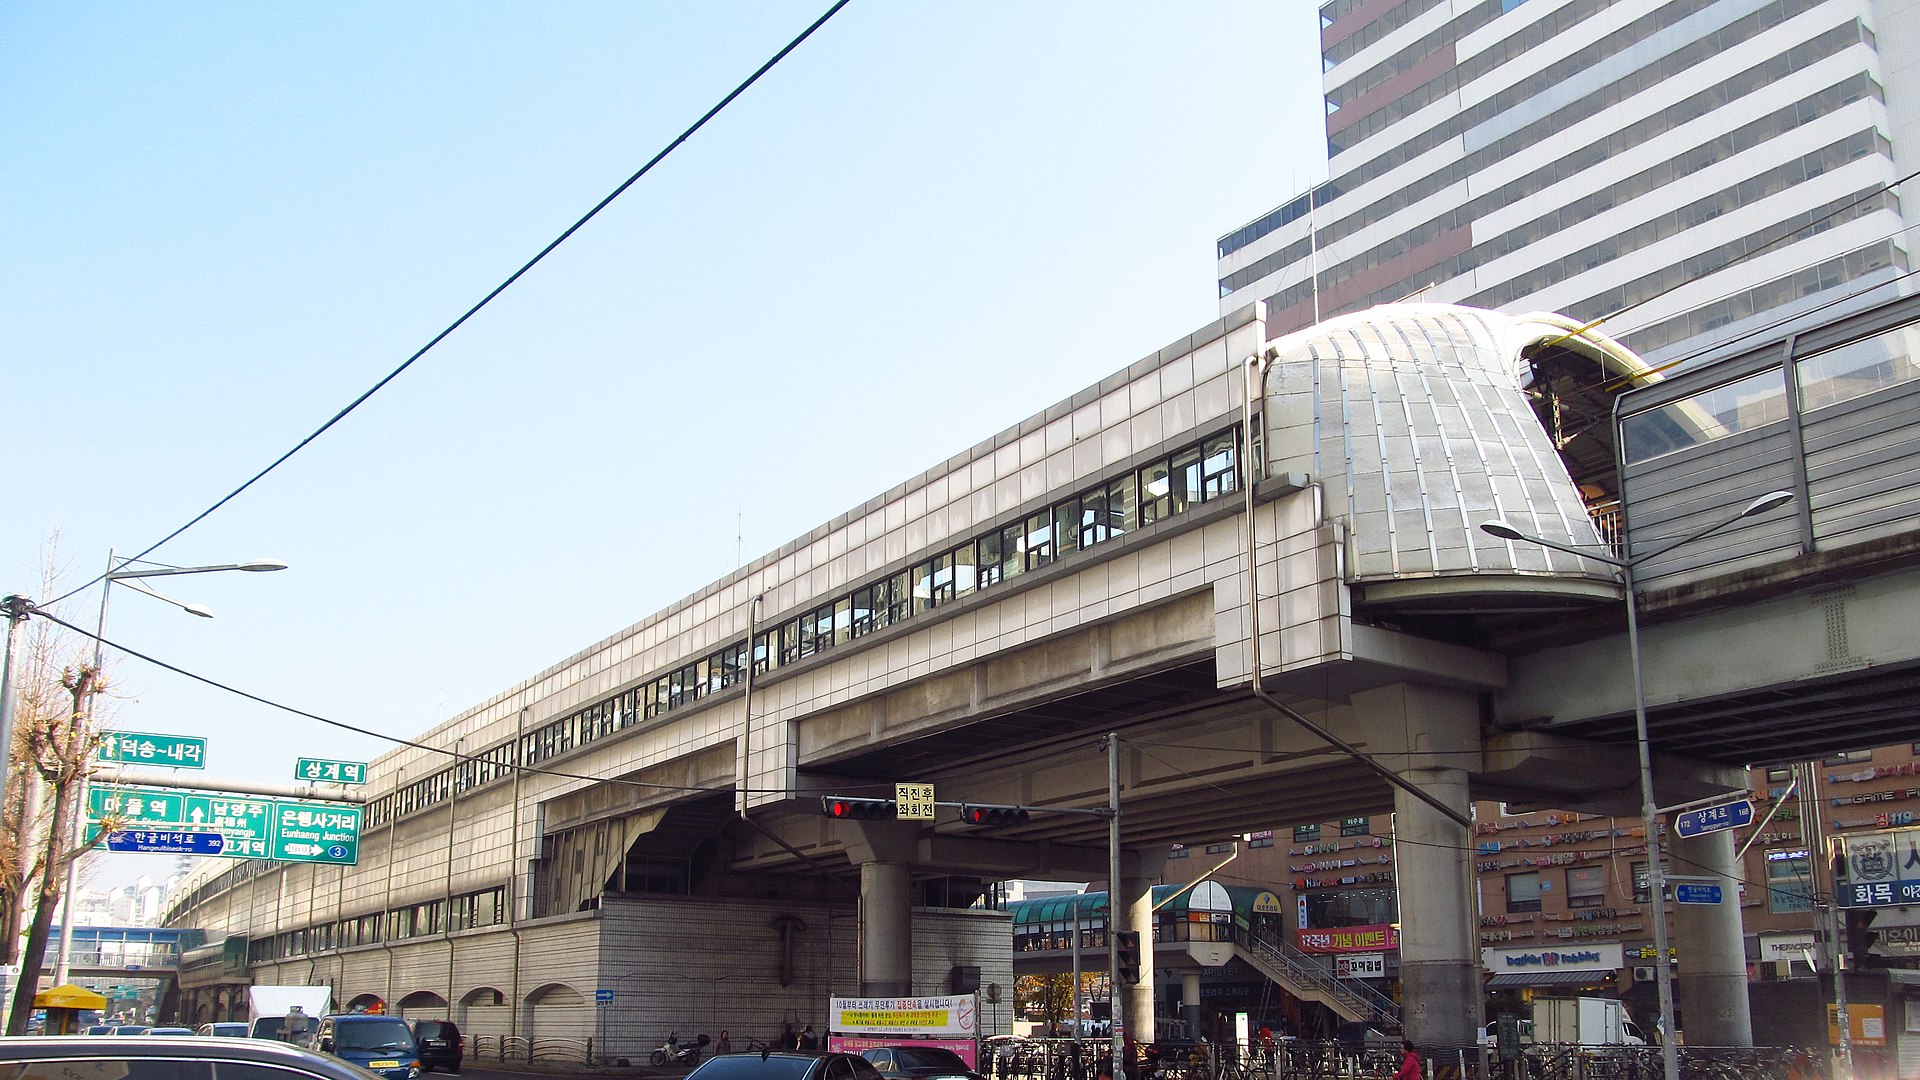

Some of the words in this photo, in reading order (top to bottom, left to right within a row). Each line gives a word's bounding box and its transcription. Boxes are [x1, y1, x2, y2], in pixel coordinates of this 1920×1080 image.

[120, 739, 202, 763] 덕송~내각
[305, 762, 361, 782] 상계역
[899, 787, 933, 800] 직진후
[213, 802, 263, 818] 남양주
[899, 803, 933, 817] 좌회전
[1698, 807, 1727, 823] 상계로
[281, 810, 355, 830] 은행사거리
[135, 832, 195, 844] 한글비석로
[281, 828, 320, 842] Eunhaeng
[322, 831, 354, 842] Junction
[335, 847, 341, 856] 3
[1855, 883, 1893, 904] 화목
[1332, 933, 1352, 948] 기념
[1355, 931, 1386, 947] 이벤트
